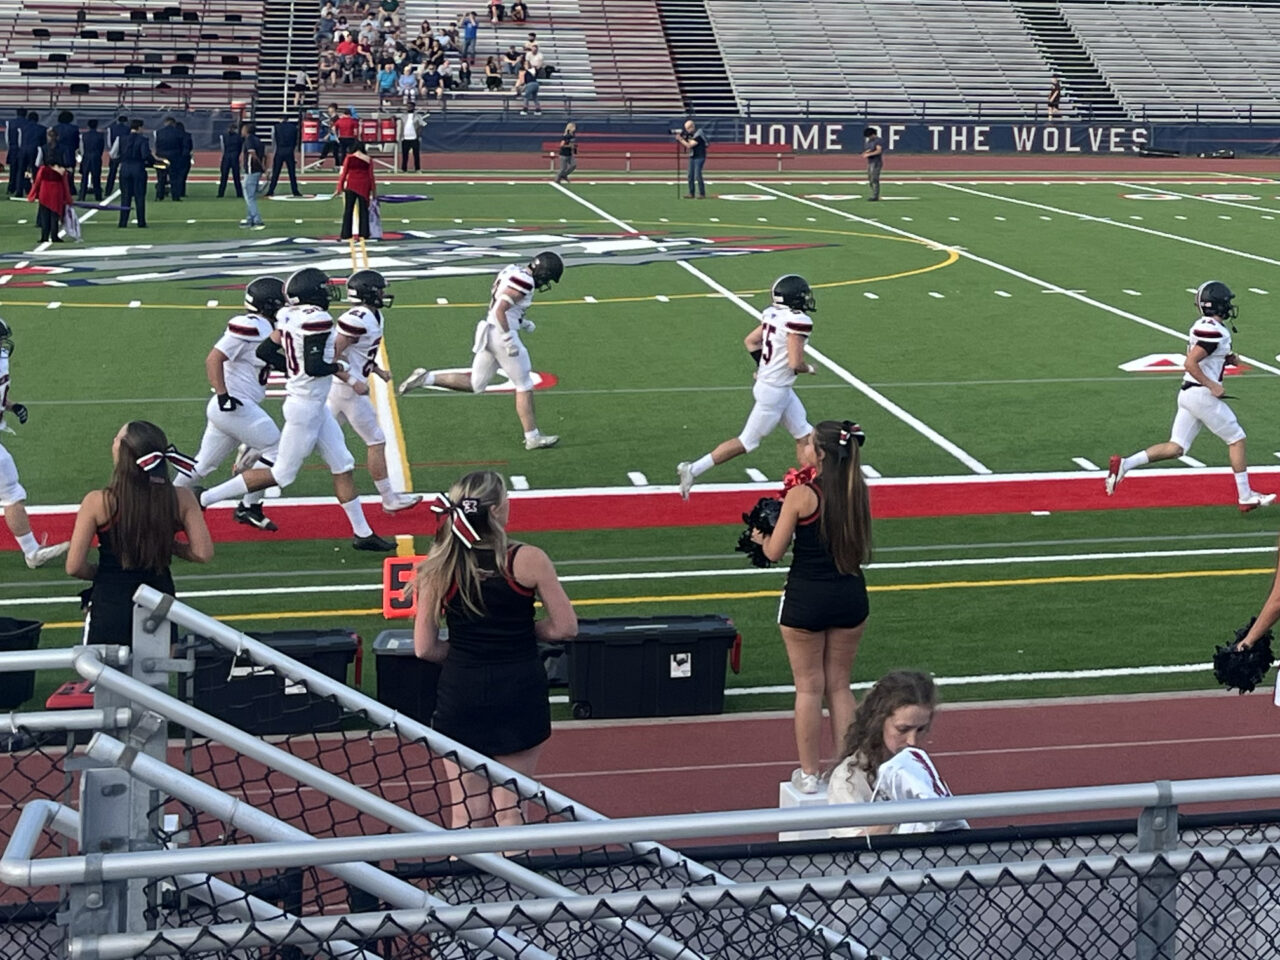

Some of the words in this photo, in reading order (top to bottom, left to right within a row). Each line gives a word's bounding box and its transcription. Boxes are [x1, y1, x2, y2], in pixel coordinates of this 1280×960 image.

[744, 124, 843, 150] HOME
[928, 126, 990, 151] THE
[1012, 126, 1148, 152] WOLVES
[390, 563, 414, 609] 5
